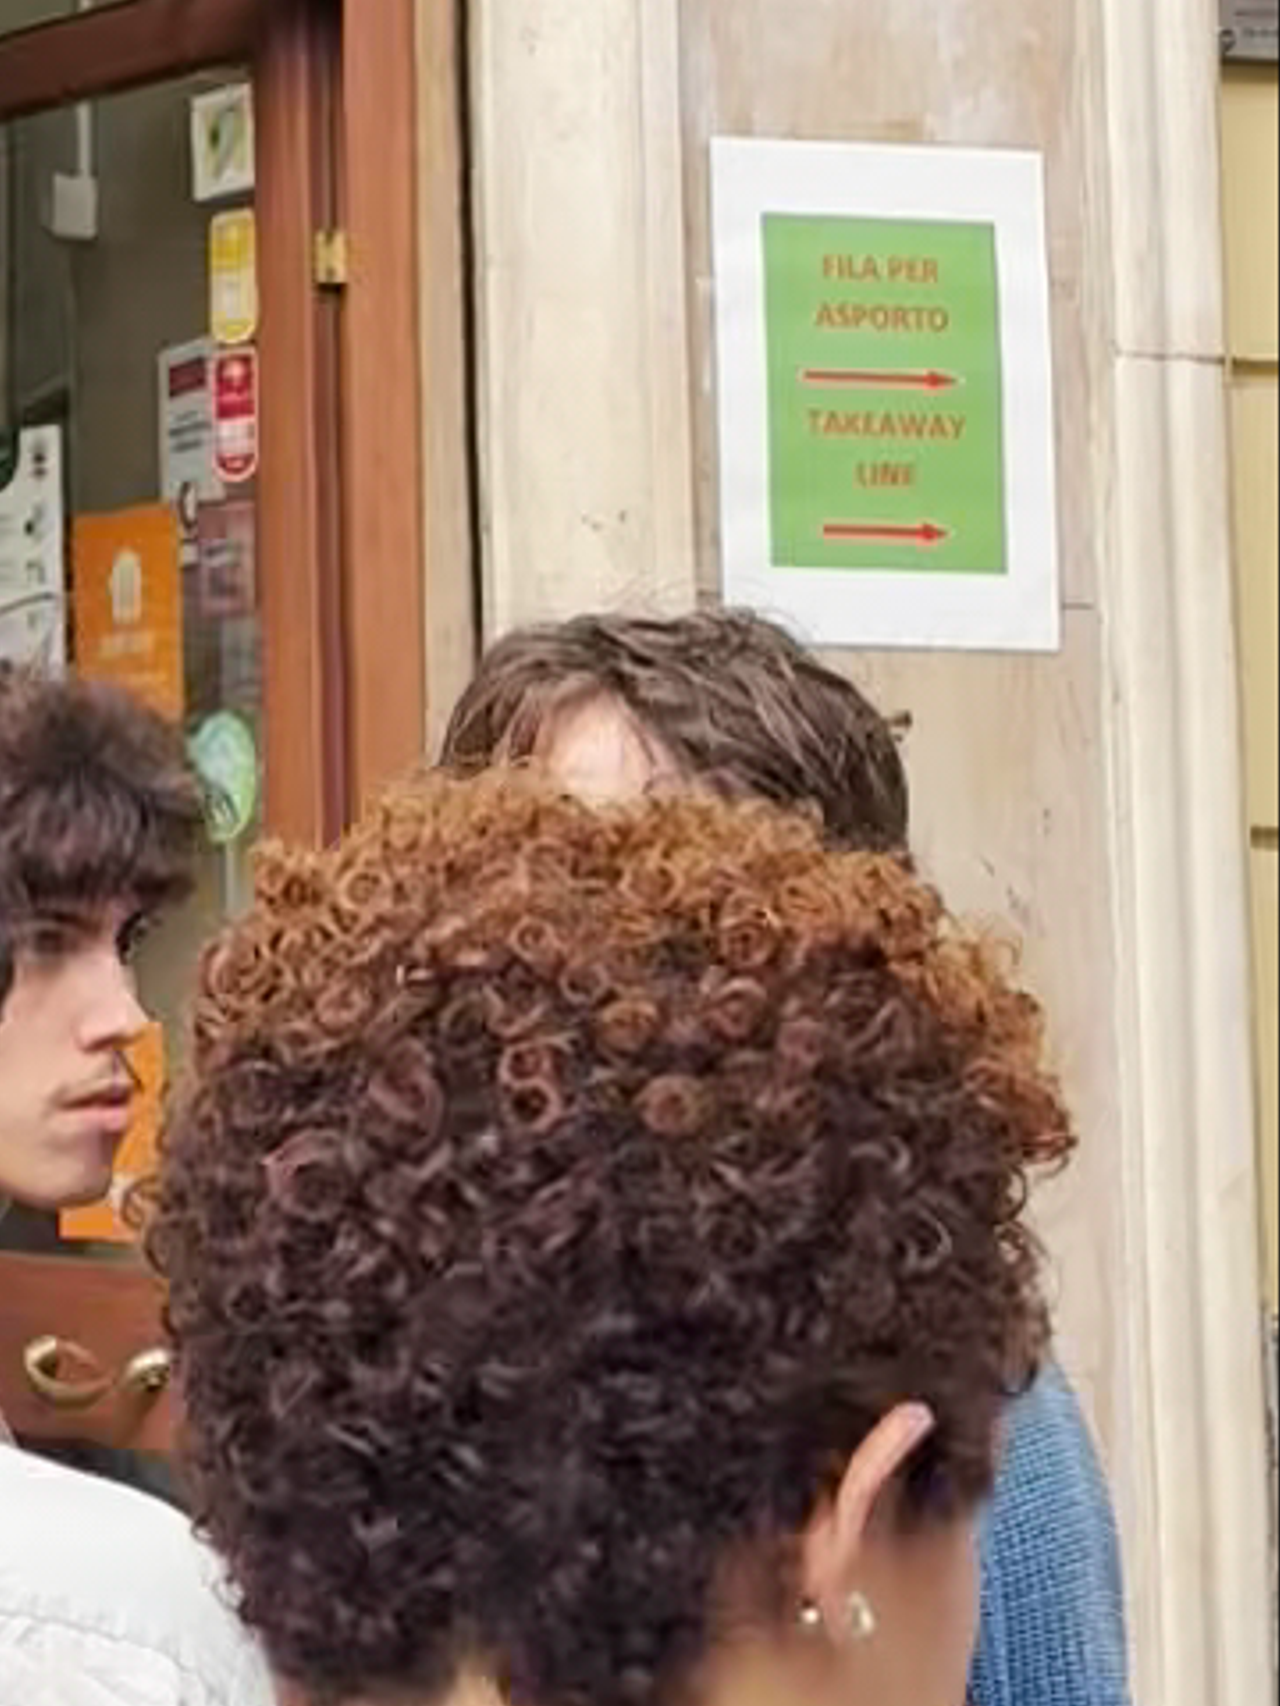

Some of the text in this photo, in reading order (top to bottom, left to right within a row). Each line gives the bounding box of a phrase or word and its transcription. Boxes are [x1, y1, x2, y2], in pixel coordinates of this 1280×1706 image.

[821, 253, 940, 285] FILA PER
[814, 301, 950, 334] ASPORTO
[807, 408, 968, 441] TAKEAWAY
[853, 460, 915, 489] LINE
